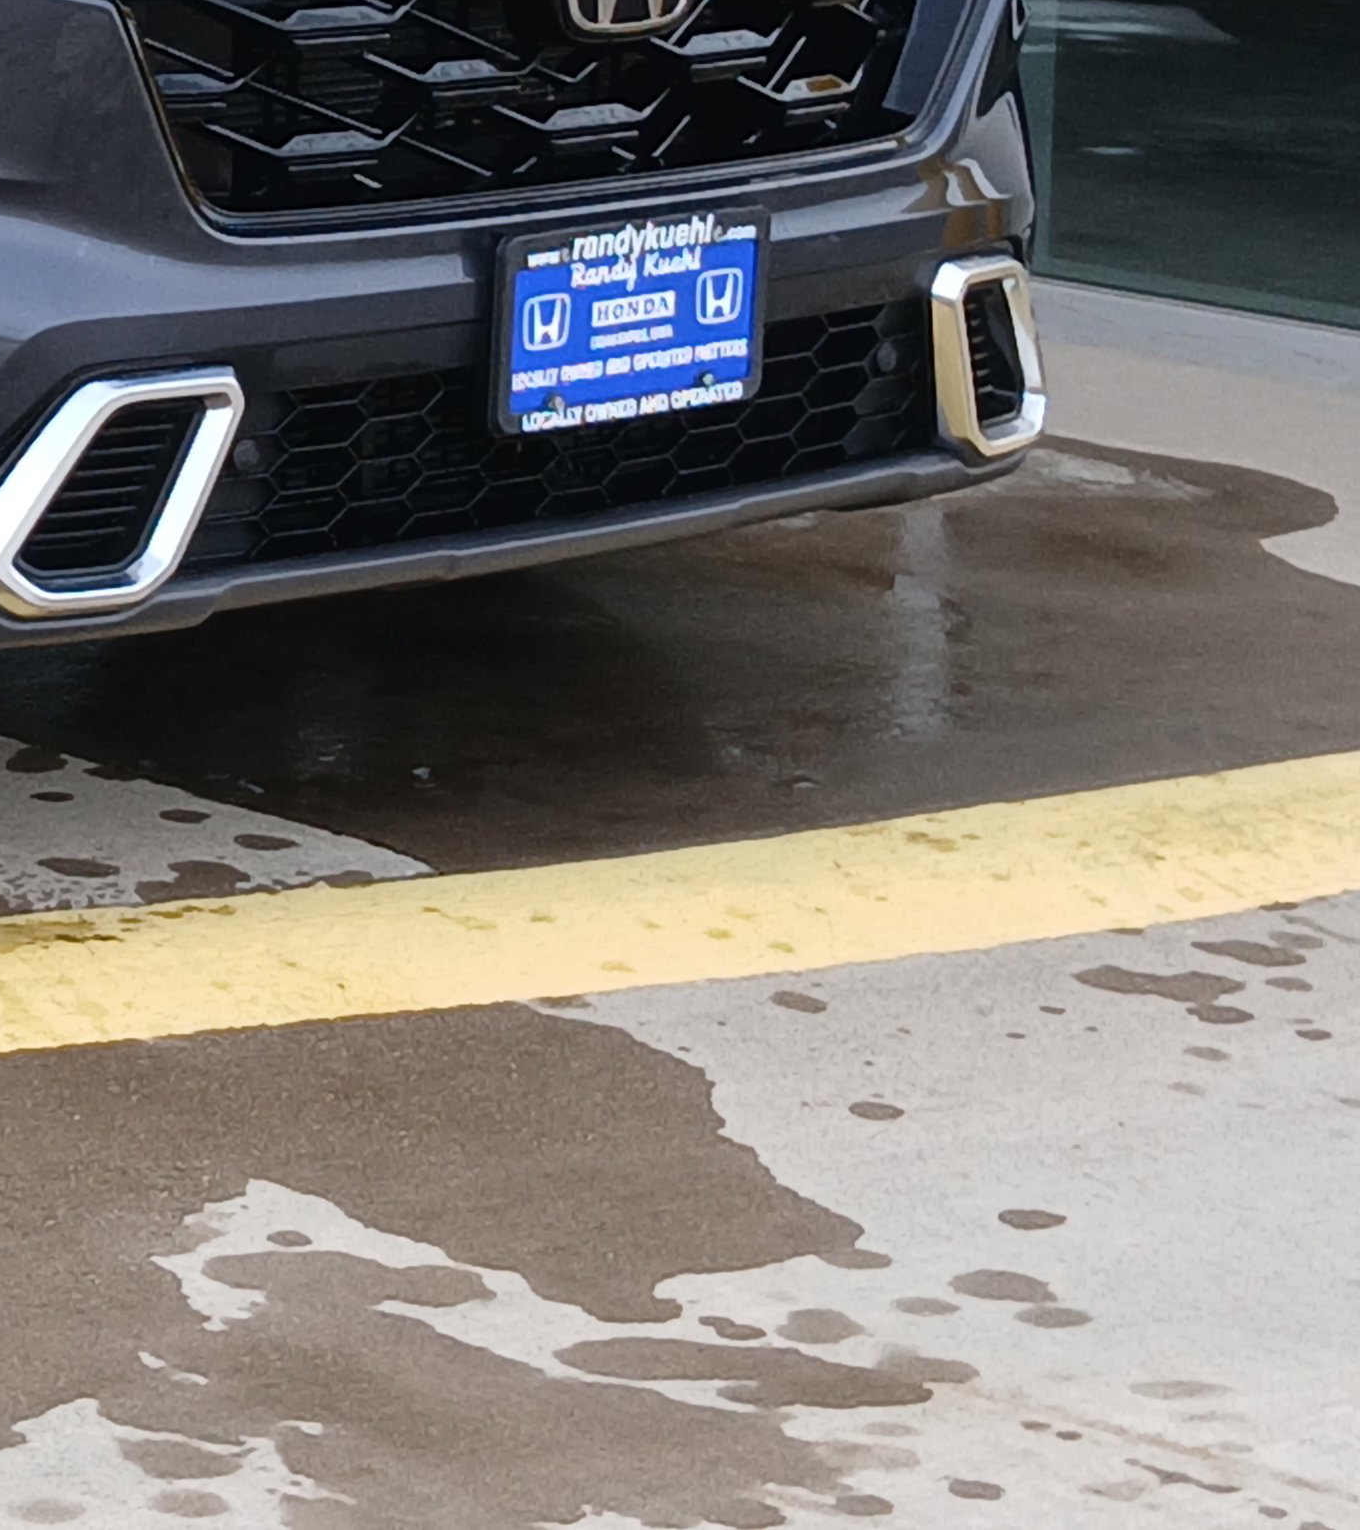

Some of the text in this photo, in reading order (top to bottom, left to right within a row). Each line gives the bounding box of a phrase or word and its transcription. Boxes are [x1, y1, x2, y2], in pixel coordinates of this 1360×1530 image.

[570, 254, 638, 292] Randy
[596, 296, 670, 322] HONDA
[522, 380, 743, 433] LOCALLY OWNED AND OPERATED
